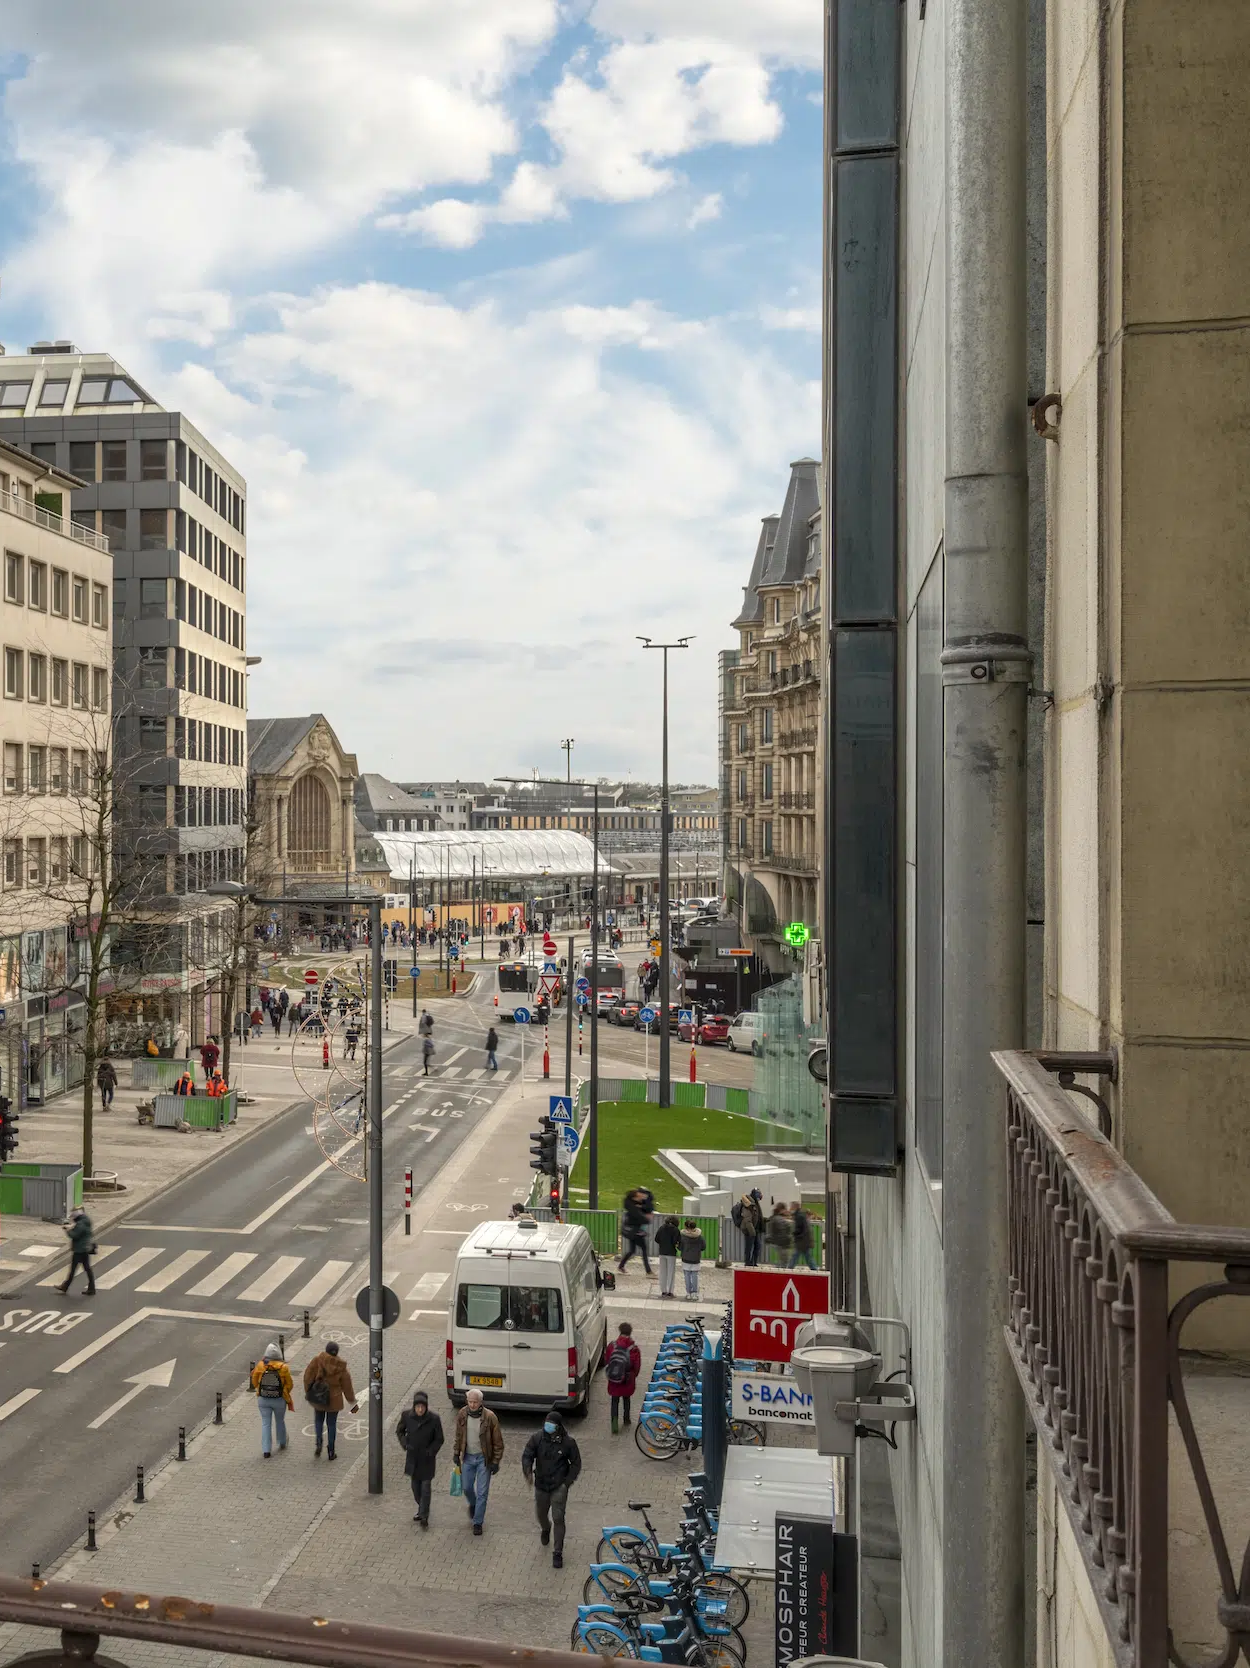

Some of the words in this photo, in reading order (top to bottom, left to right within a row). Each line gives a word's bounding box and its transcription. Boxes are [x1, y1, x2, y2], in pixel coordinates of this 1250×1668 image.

[411, 1107, 466, 1118] BUS
[748, 1406, 813, 1420] bancomat
[799, 1546, 808, 1616] CREATEUR
